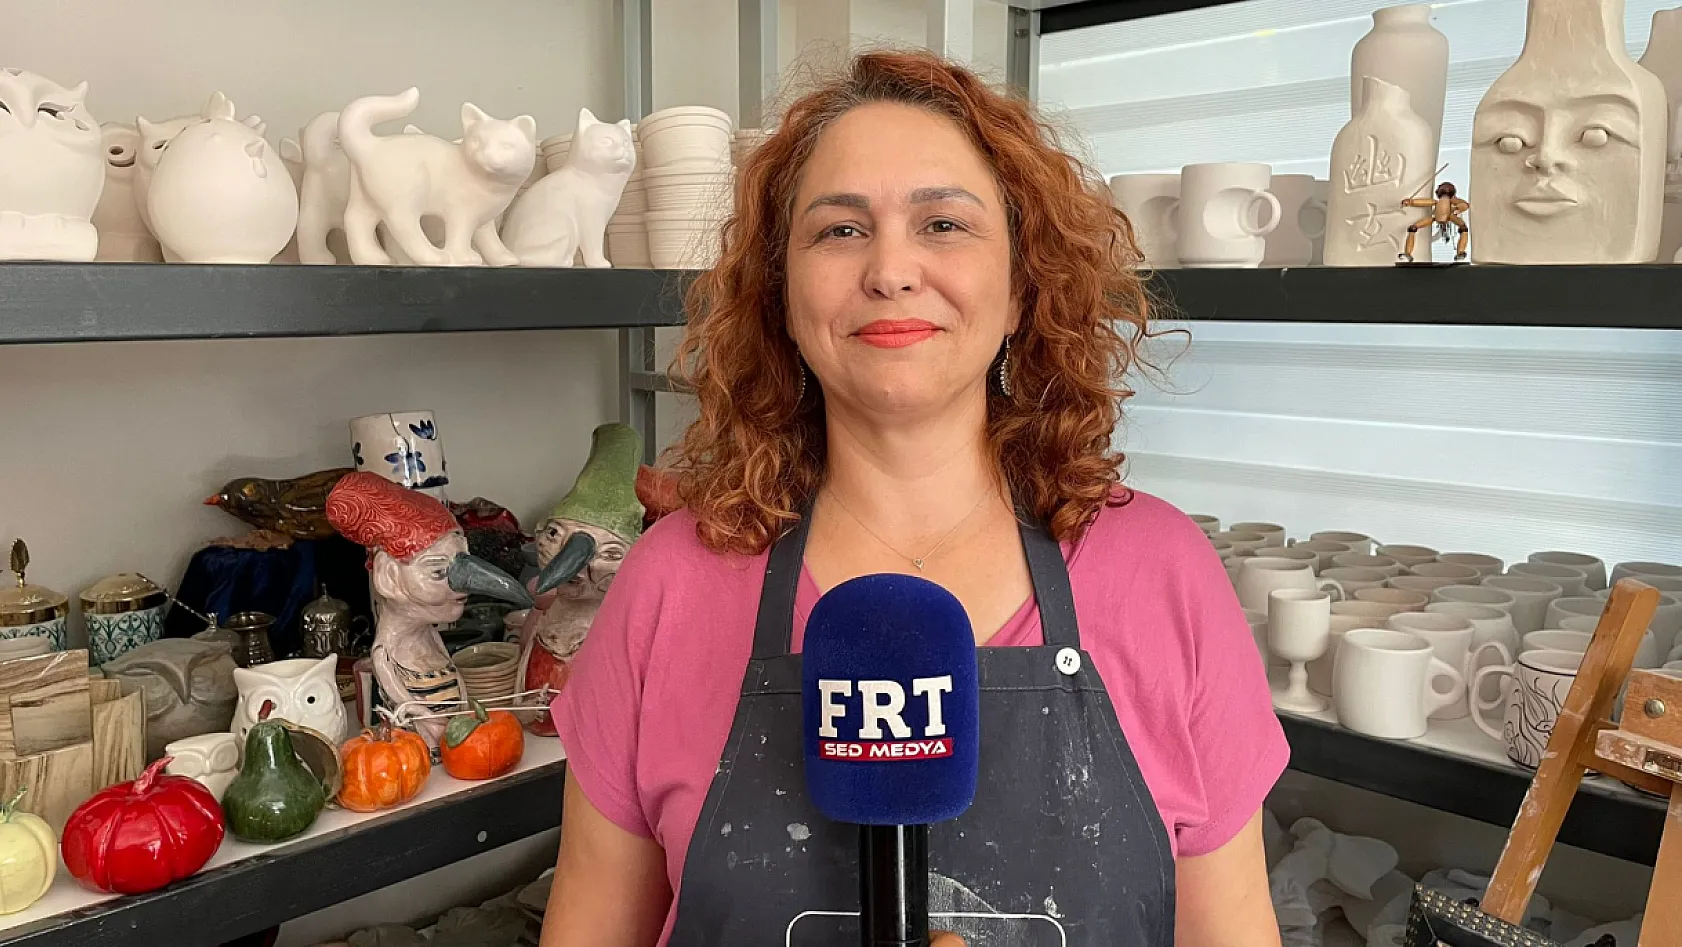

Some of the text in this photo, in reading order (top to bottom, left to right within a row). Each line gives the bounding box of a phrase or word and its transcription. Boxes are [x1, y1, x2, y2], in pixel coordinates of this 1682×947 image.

[818, 675, 953, 739] FRT
[825, 741, 947, 758] SED MEDYA
